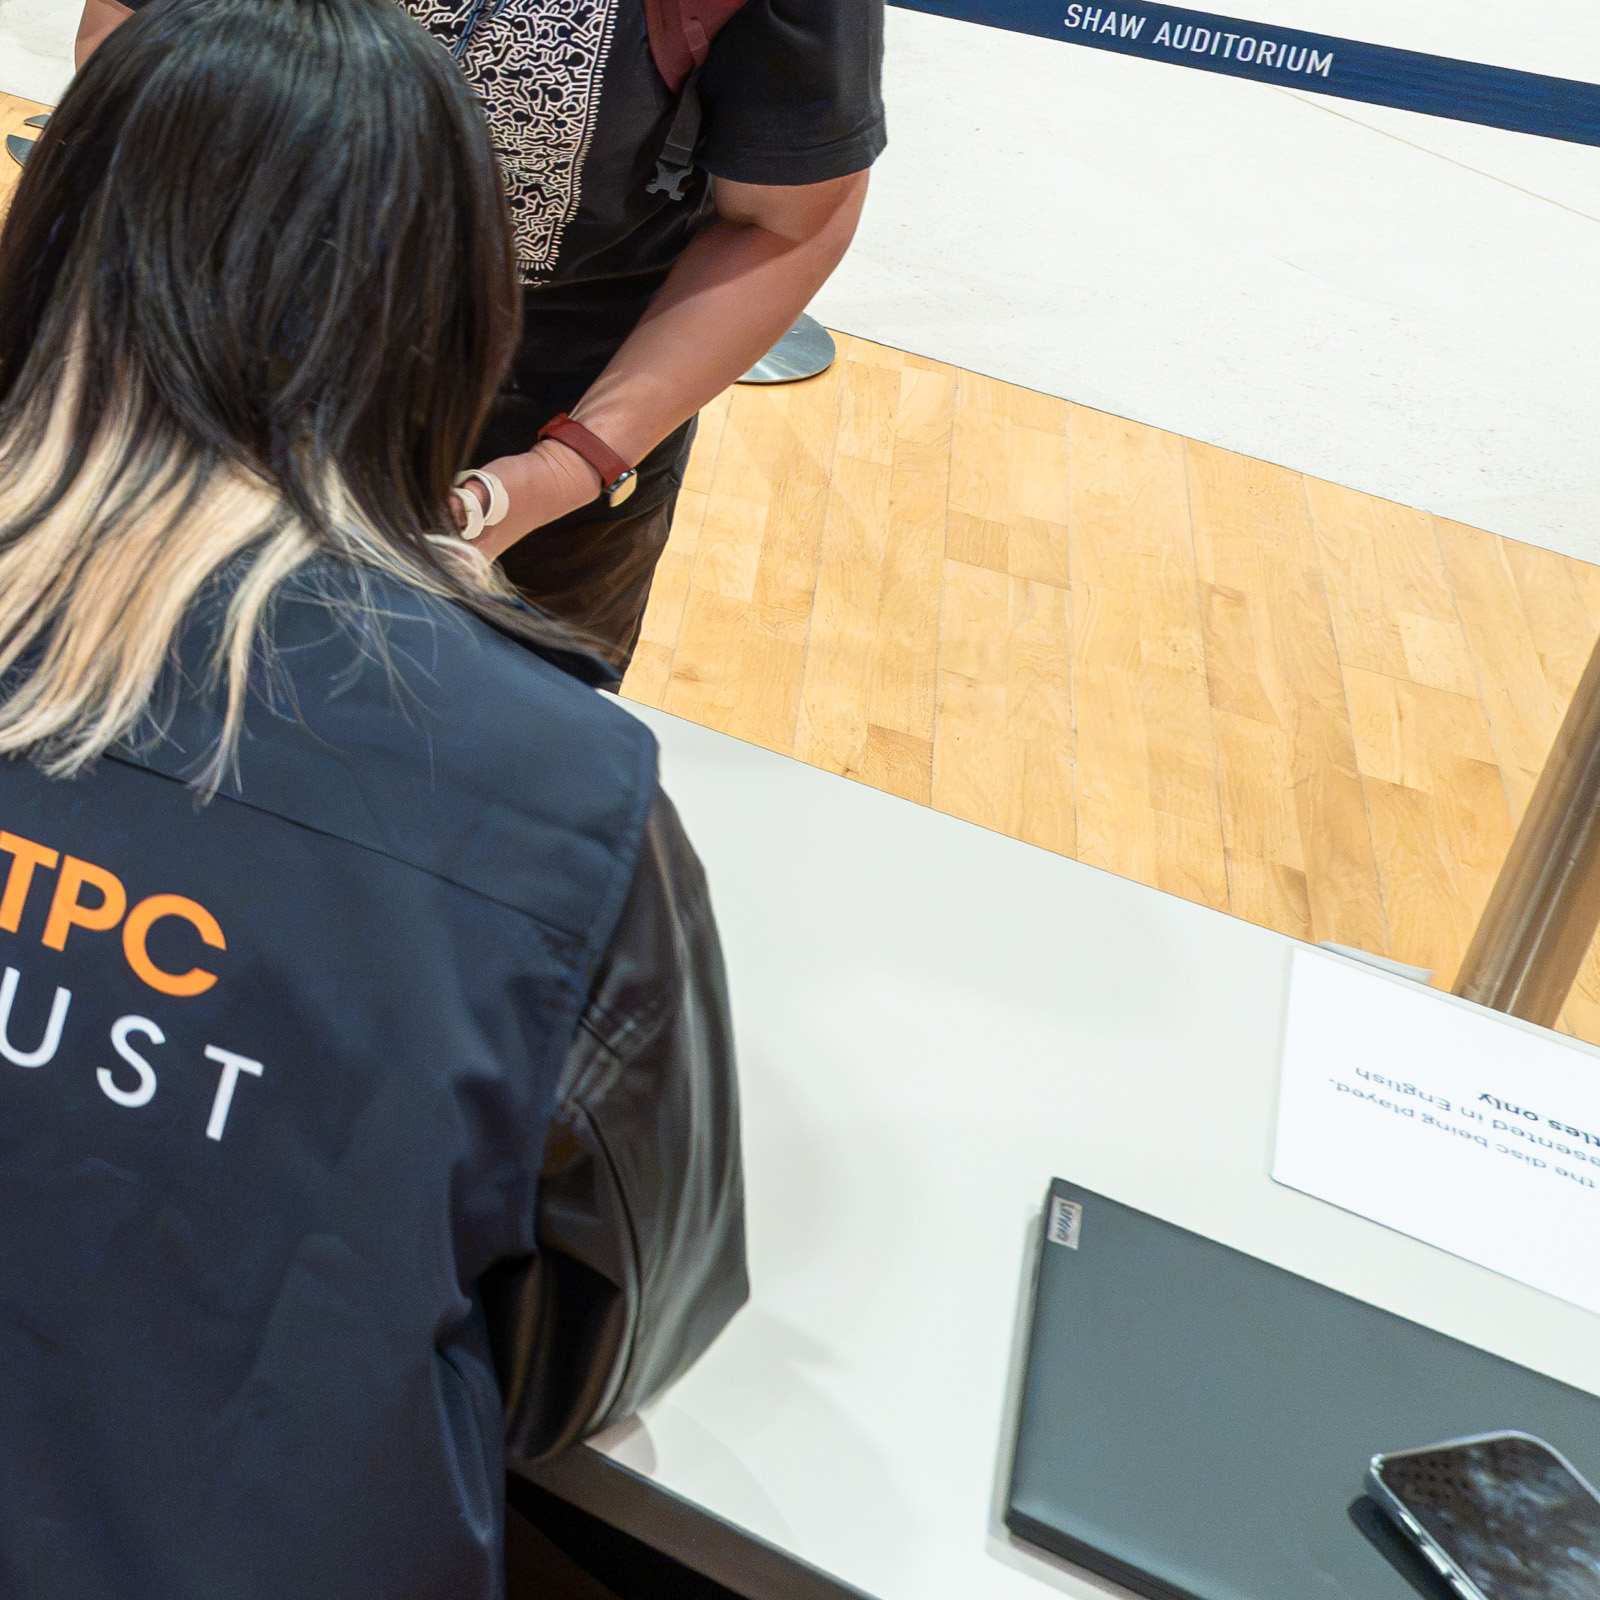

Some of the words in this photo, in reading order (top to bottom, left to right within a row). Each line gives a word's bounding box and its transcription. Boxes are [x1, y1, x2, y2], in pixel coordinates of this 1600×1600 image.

[1064, 3, 1145, 40] SHAW
[1152, 20, 1333, 78] AUDITORIUM
[1329, 1078, 1415, 1118] played.
[1355, 1066, 1451, 1112] English
[1460, 1106, 1484, 1122] in
[1477, 1092, 1539, 1122] only
[1421, 1113, 1489, 1148] being
[1496, 1143, 1547, 1169] disc
